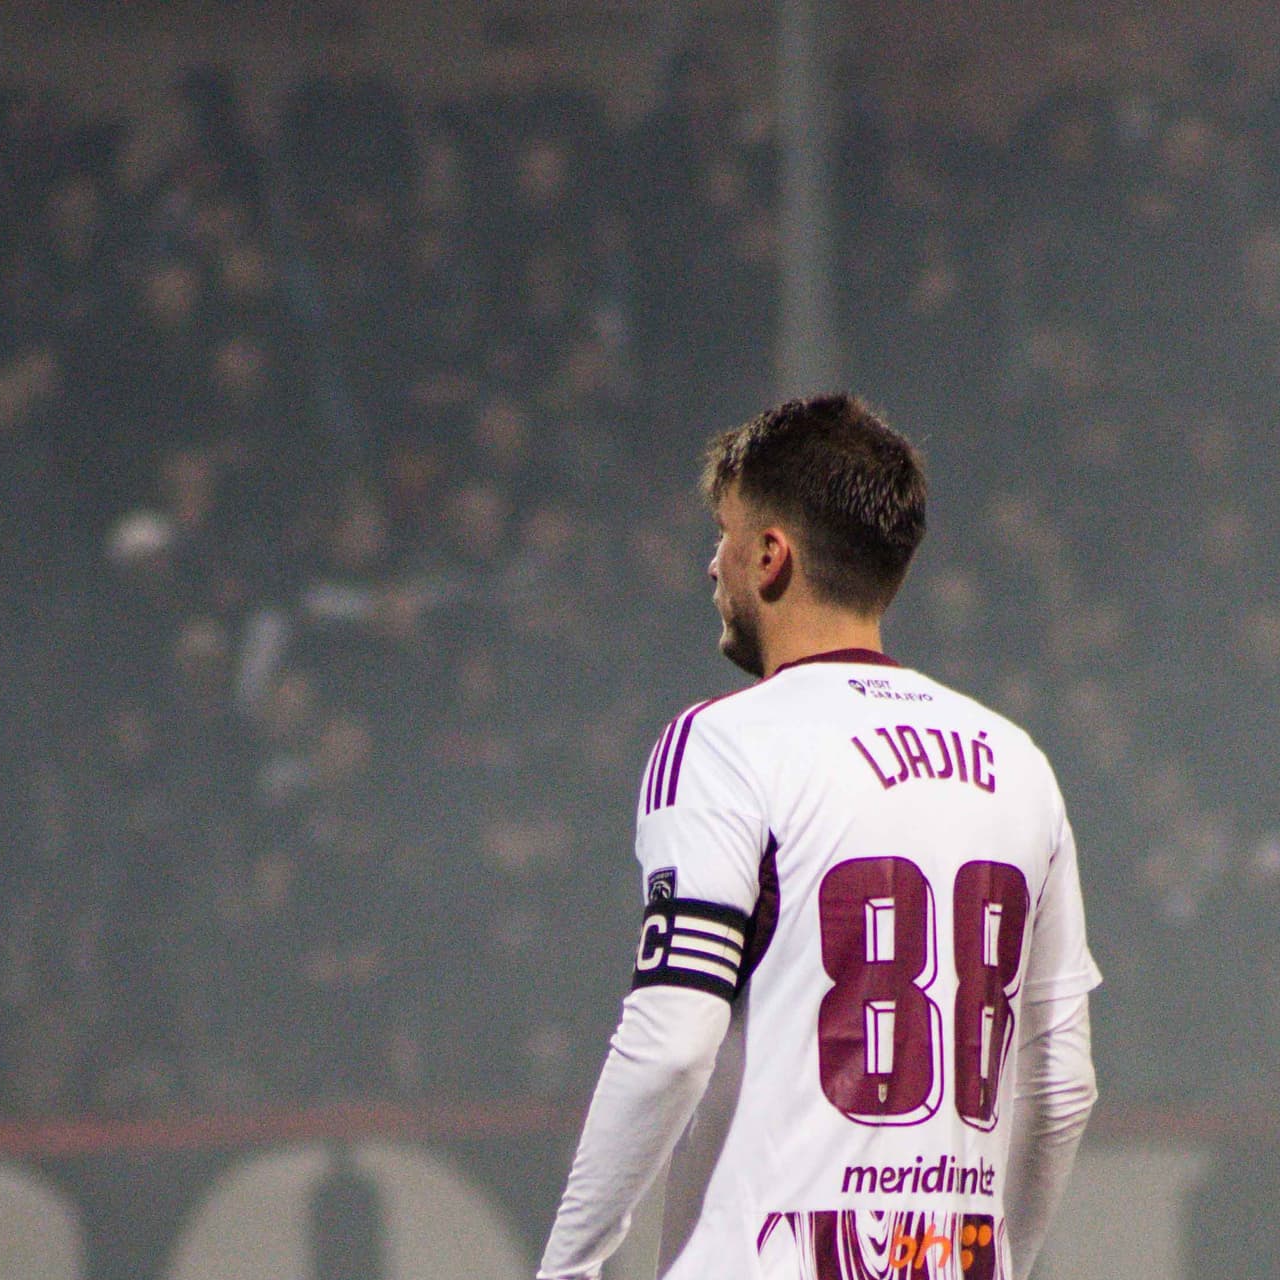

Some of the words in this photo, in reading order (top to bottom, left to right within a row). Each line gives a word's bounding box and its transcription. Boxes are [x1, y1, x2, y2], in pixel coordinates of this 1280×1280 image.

[861, 678, 891, 689] VISIT
[869, 689, 934, 701] SARAJEVO
[851, 725, 996, 793] LJAJIĆ
[637, 914, 667, 971] C
[818, 856, 1031, 1132] 88
